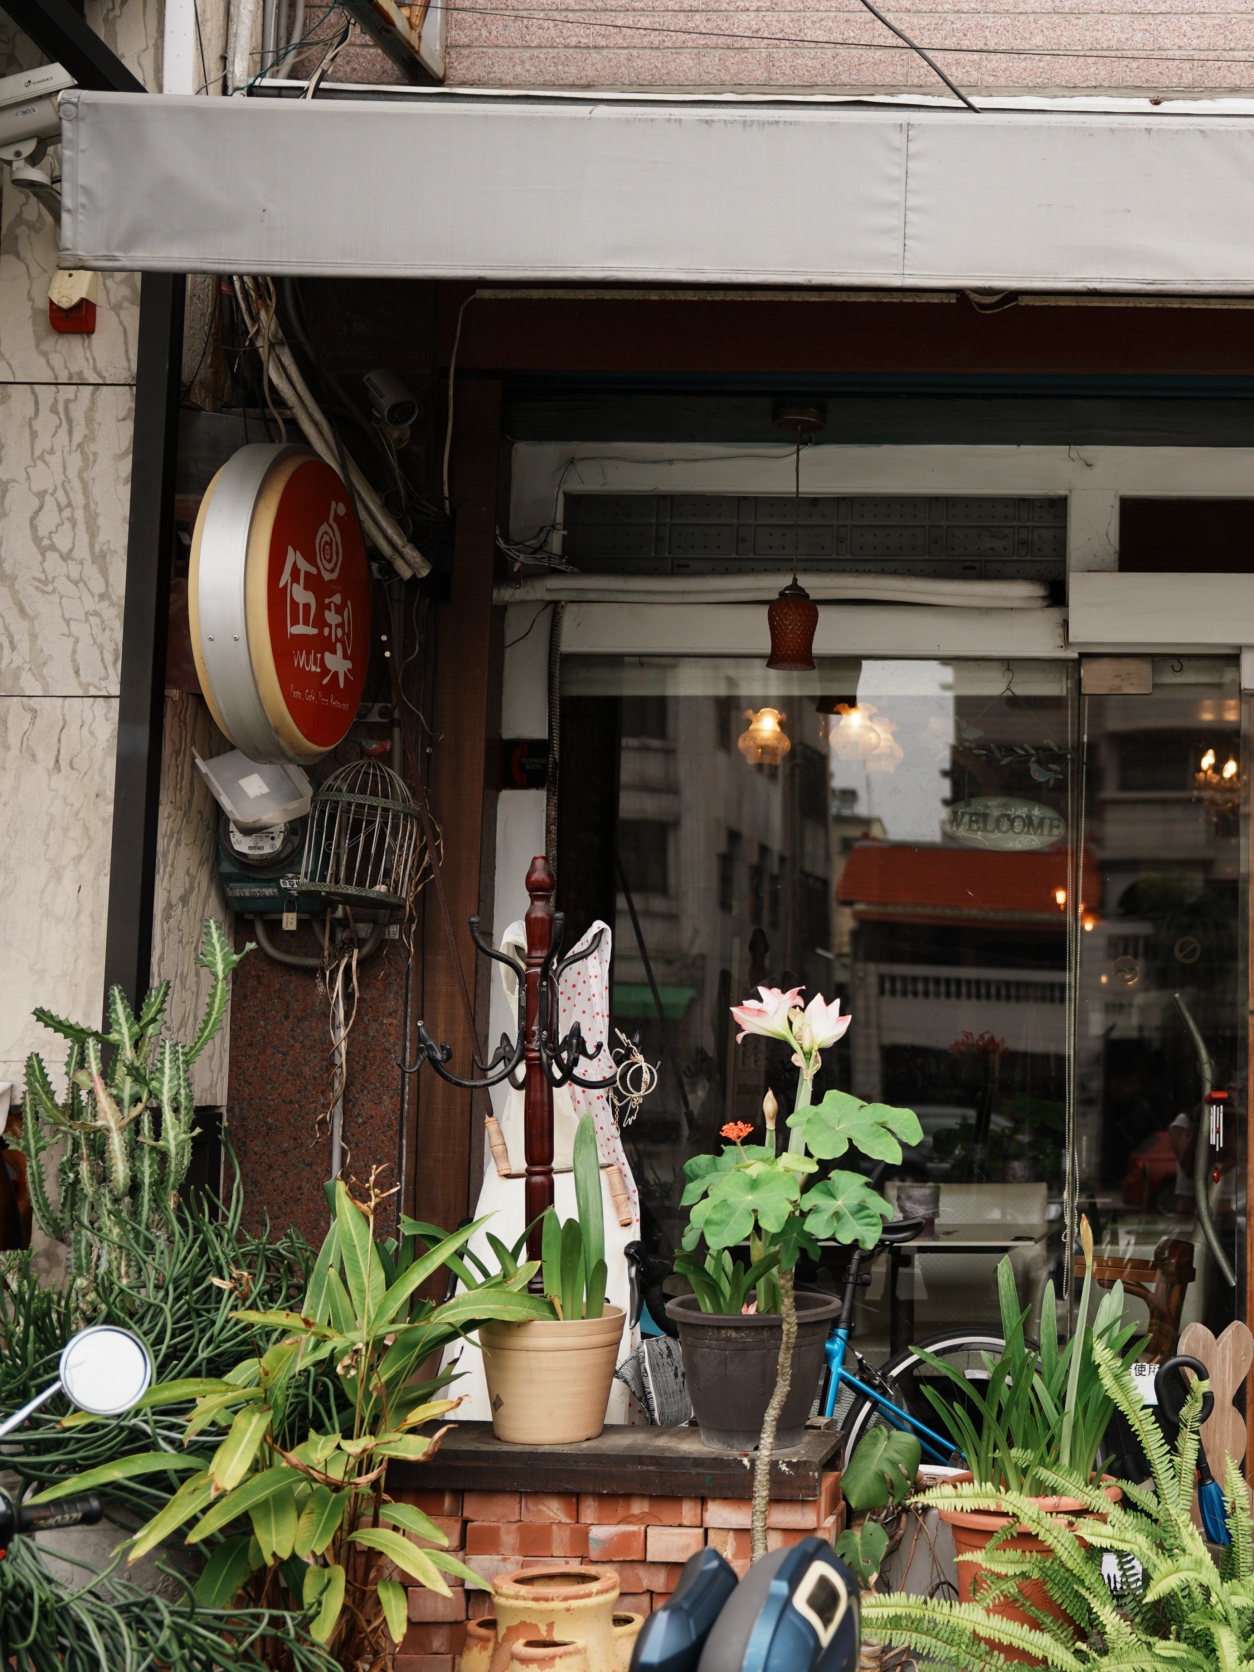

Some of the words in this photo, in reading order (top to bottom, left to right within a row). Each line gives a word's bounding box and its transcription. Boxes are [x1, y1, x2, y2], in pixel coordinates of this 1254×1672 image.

[292, 650, 322, 673] WULI
[950, 810, 1063, 838] WELCOME
[1128, 1363, 1160, 1377] 使用
